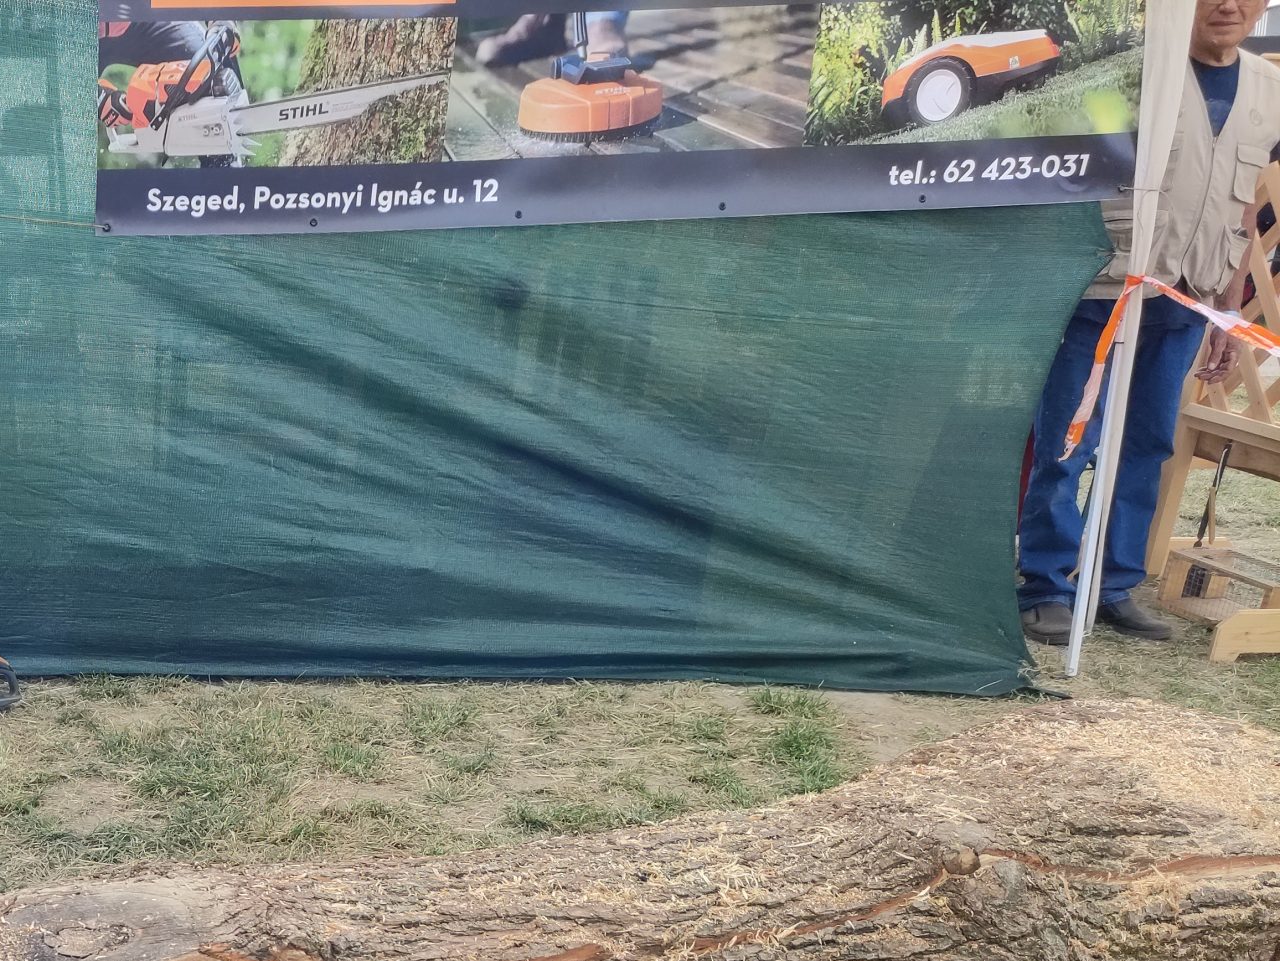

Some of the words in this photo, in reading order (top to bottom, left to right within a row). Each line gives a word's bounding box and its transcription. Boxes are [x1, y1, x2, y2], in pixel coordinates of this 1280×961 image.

[278, 103, 329, 122] STIHL
[889, 160, 936, 186] tel.:
[943, 159, 976, 183] 62
[981, 153, 1090, 181] 423-031
[146, 185, 246, 217] Szeged,
[253, 185, 363, 214] Pozsonyi
[371, 182, 436, 212] Ignác
[443, 188, 465, 203] u.
[473, 179, 500, 202] 12
